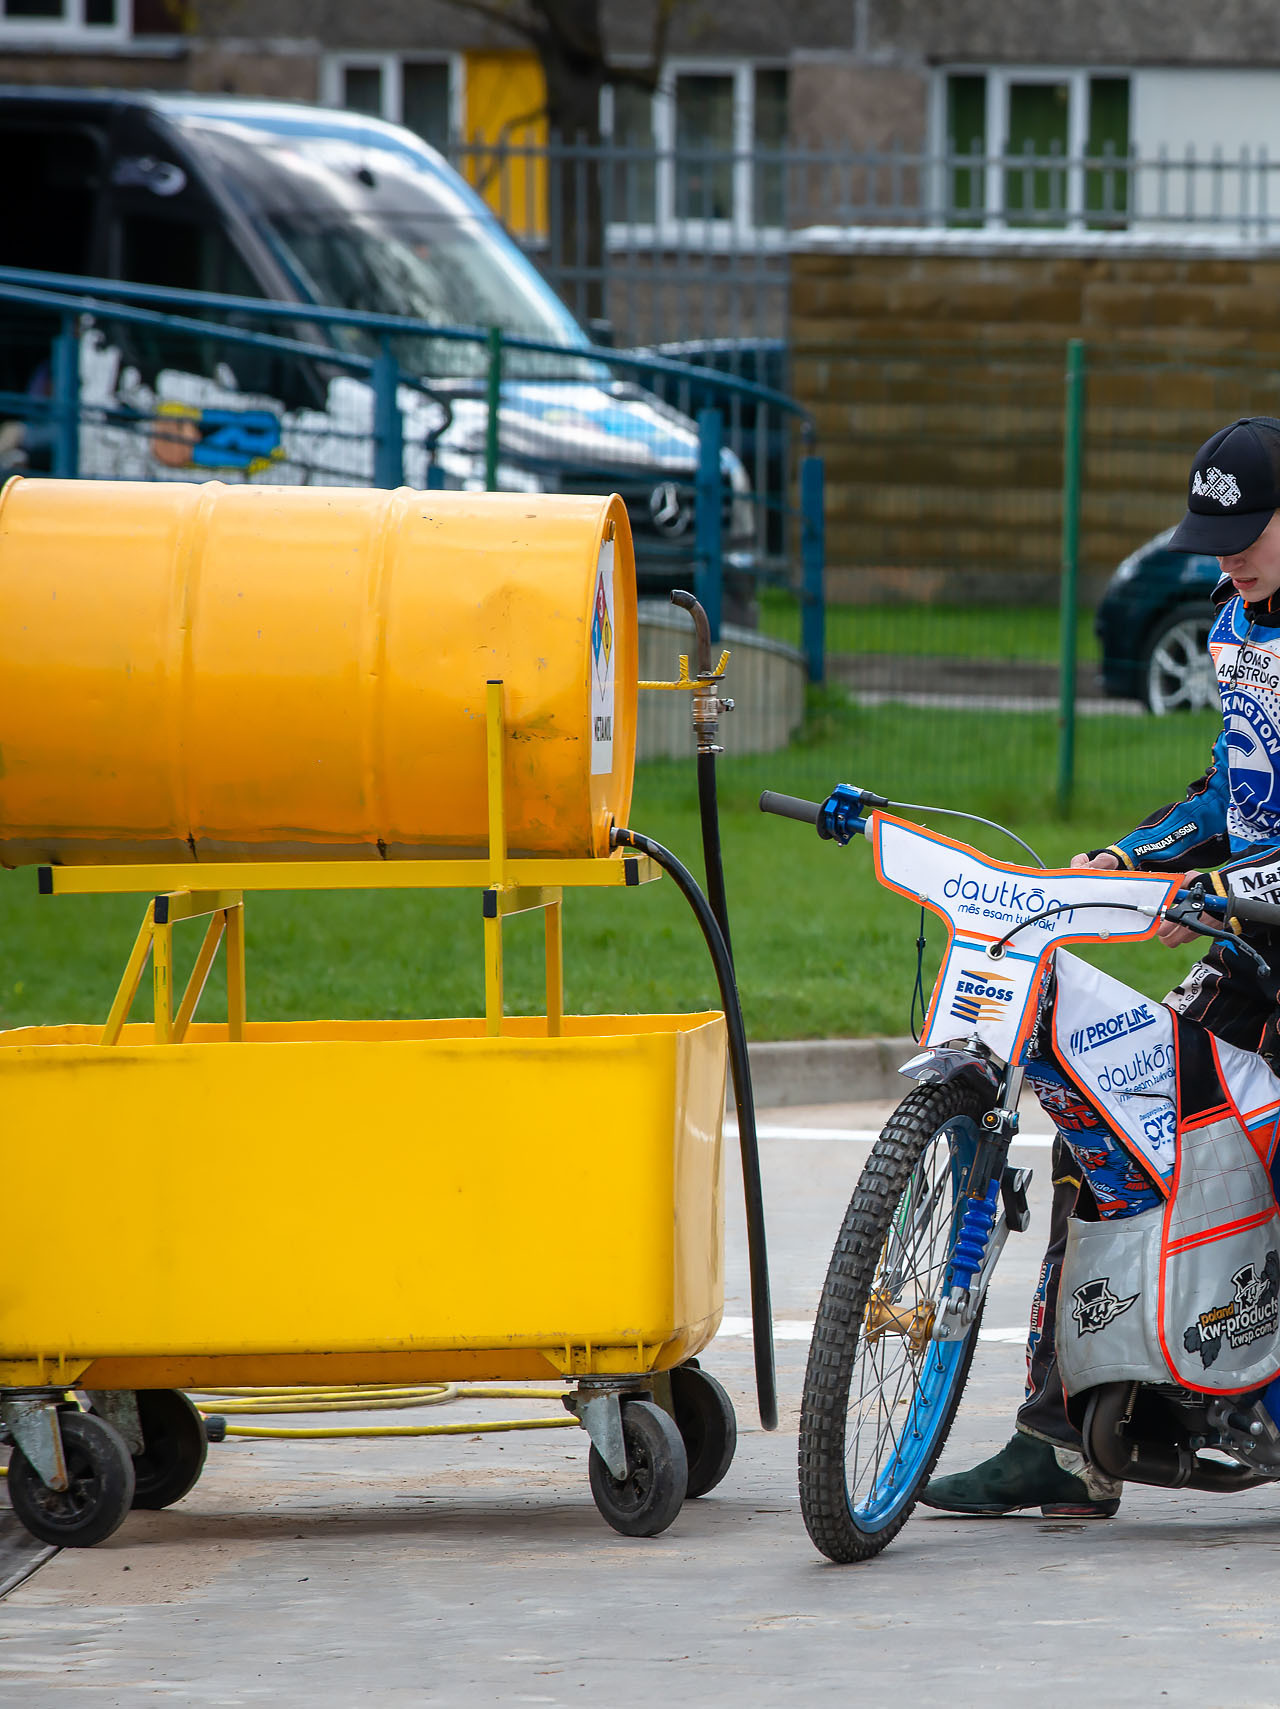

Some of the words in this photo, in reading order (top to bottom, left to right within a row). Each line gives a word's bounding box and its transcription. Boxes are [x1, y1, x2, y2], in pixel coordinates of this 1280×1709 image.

[982, 907, 1014, 923] esam
[955, 980, 1015, 1002] ERGOSS
[1197, 1296, 1279, 1342] kw-products
[1200, 1302, 1235, 1327] poland
[1231, 1319, 1279, 1347] kwsp.com.p
